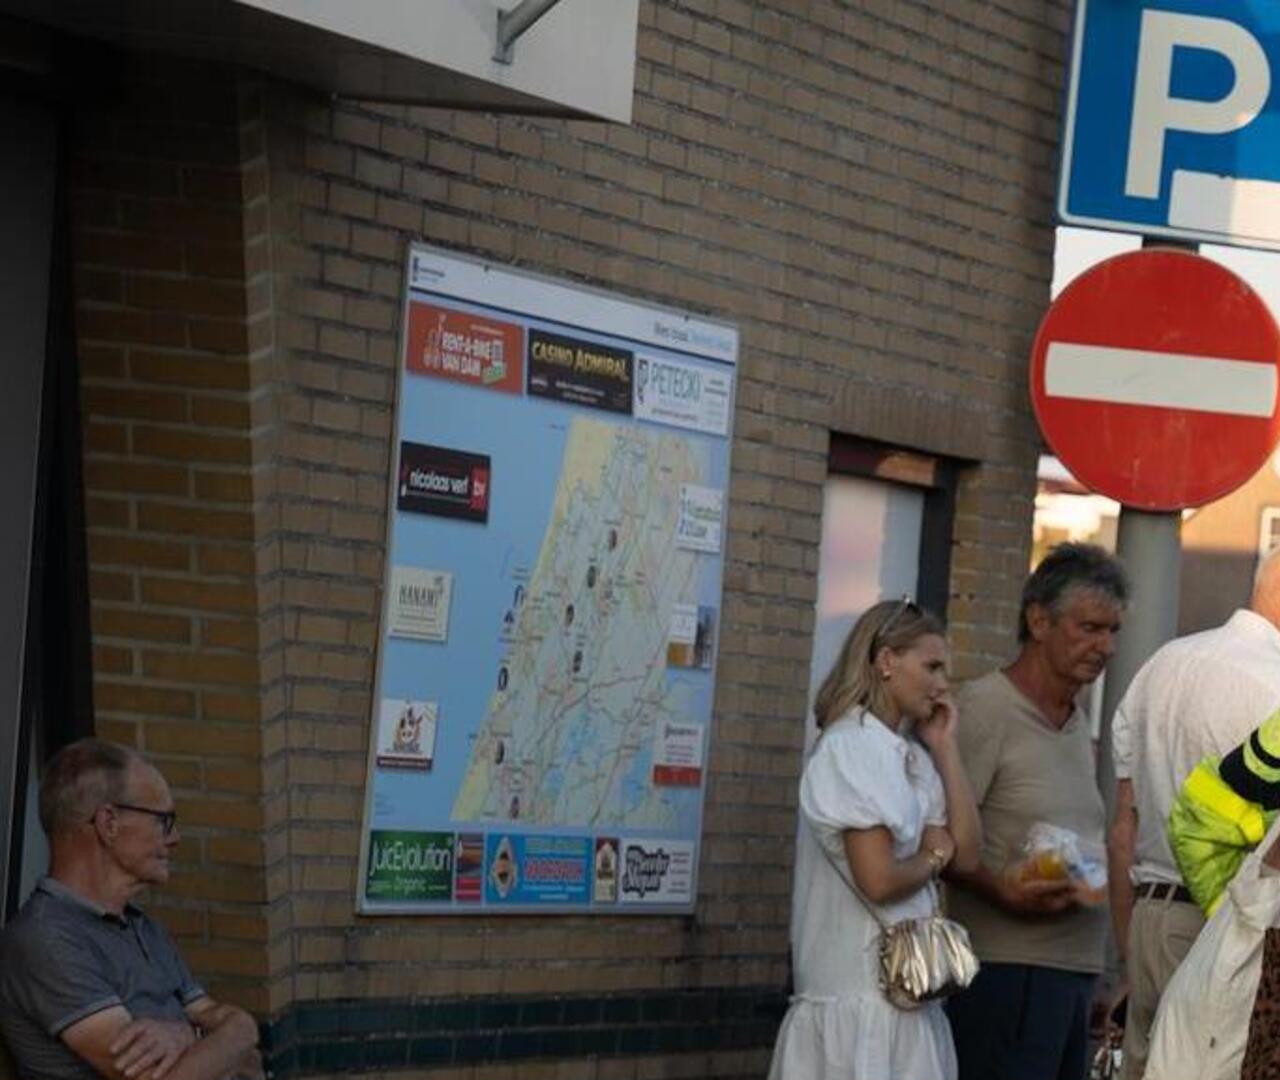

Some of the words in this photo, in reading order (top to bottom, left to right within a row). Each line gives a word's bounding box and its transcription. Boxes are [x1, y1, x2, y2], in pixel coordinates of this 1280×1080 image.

[1124, 9, 1271, 200] P
[531, 341, 574, 367] CASINO
[573, 348, 629, 382] ADMIRAL
